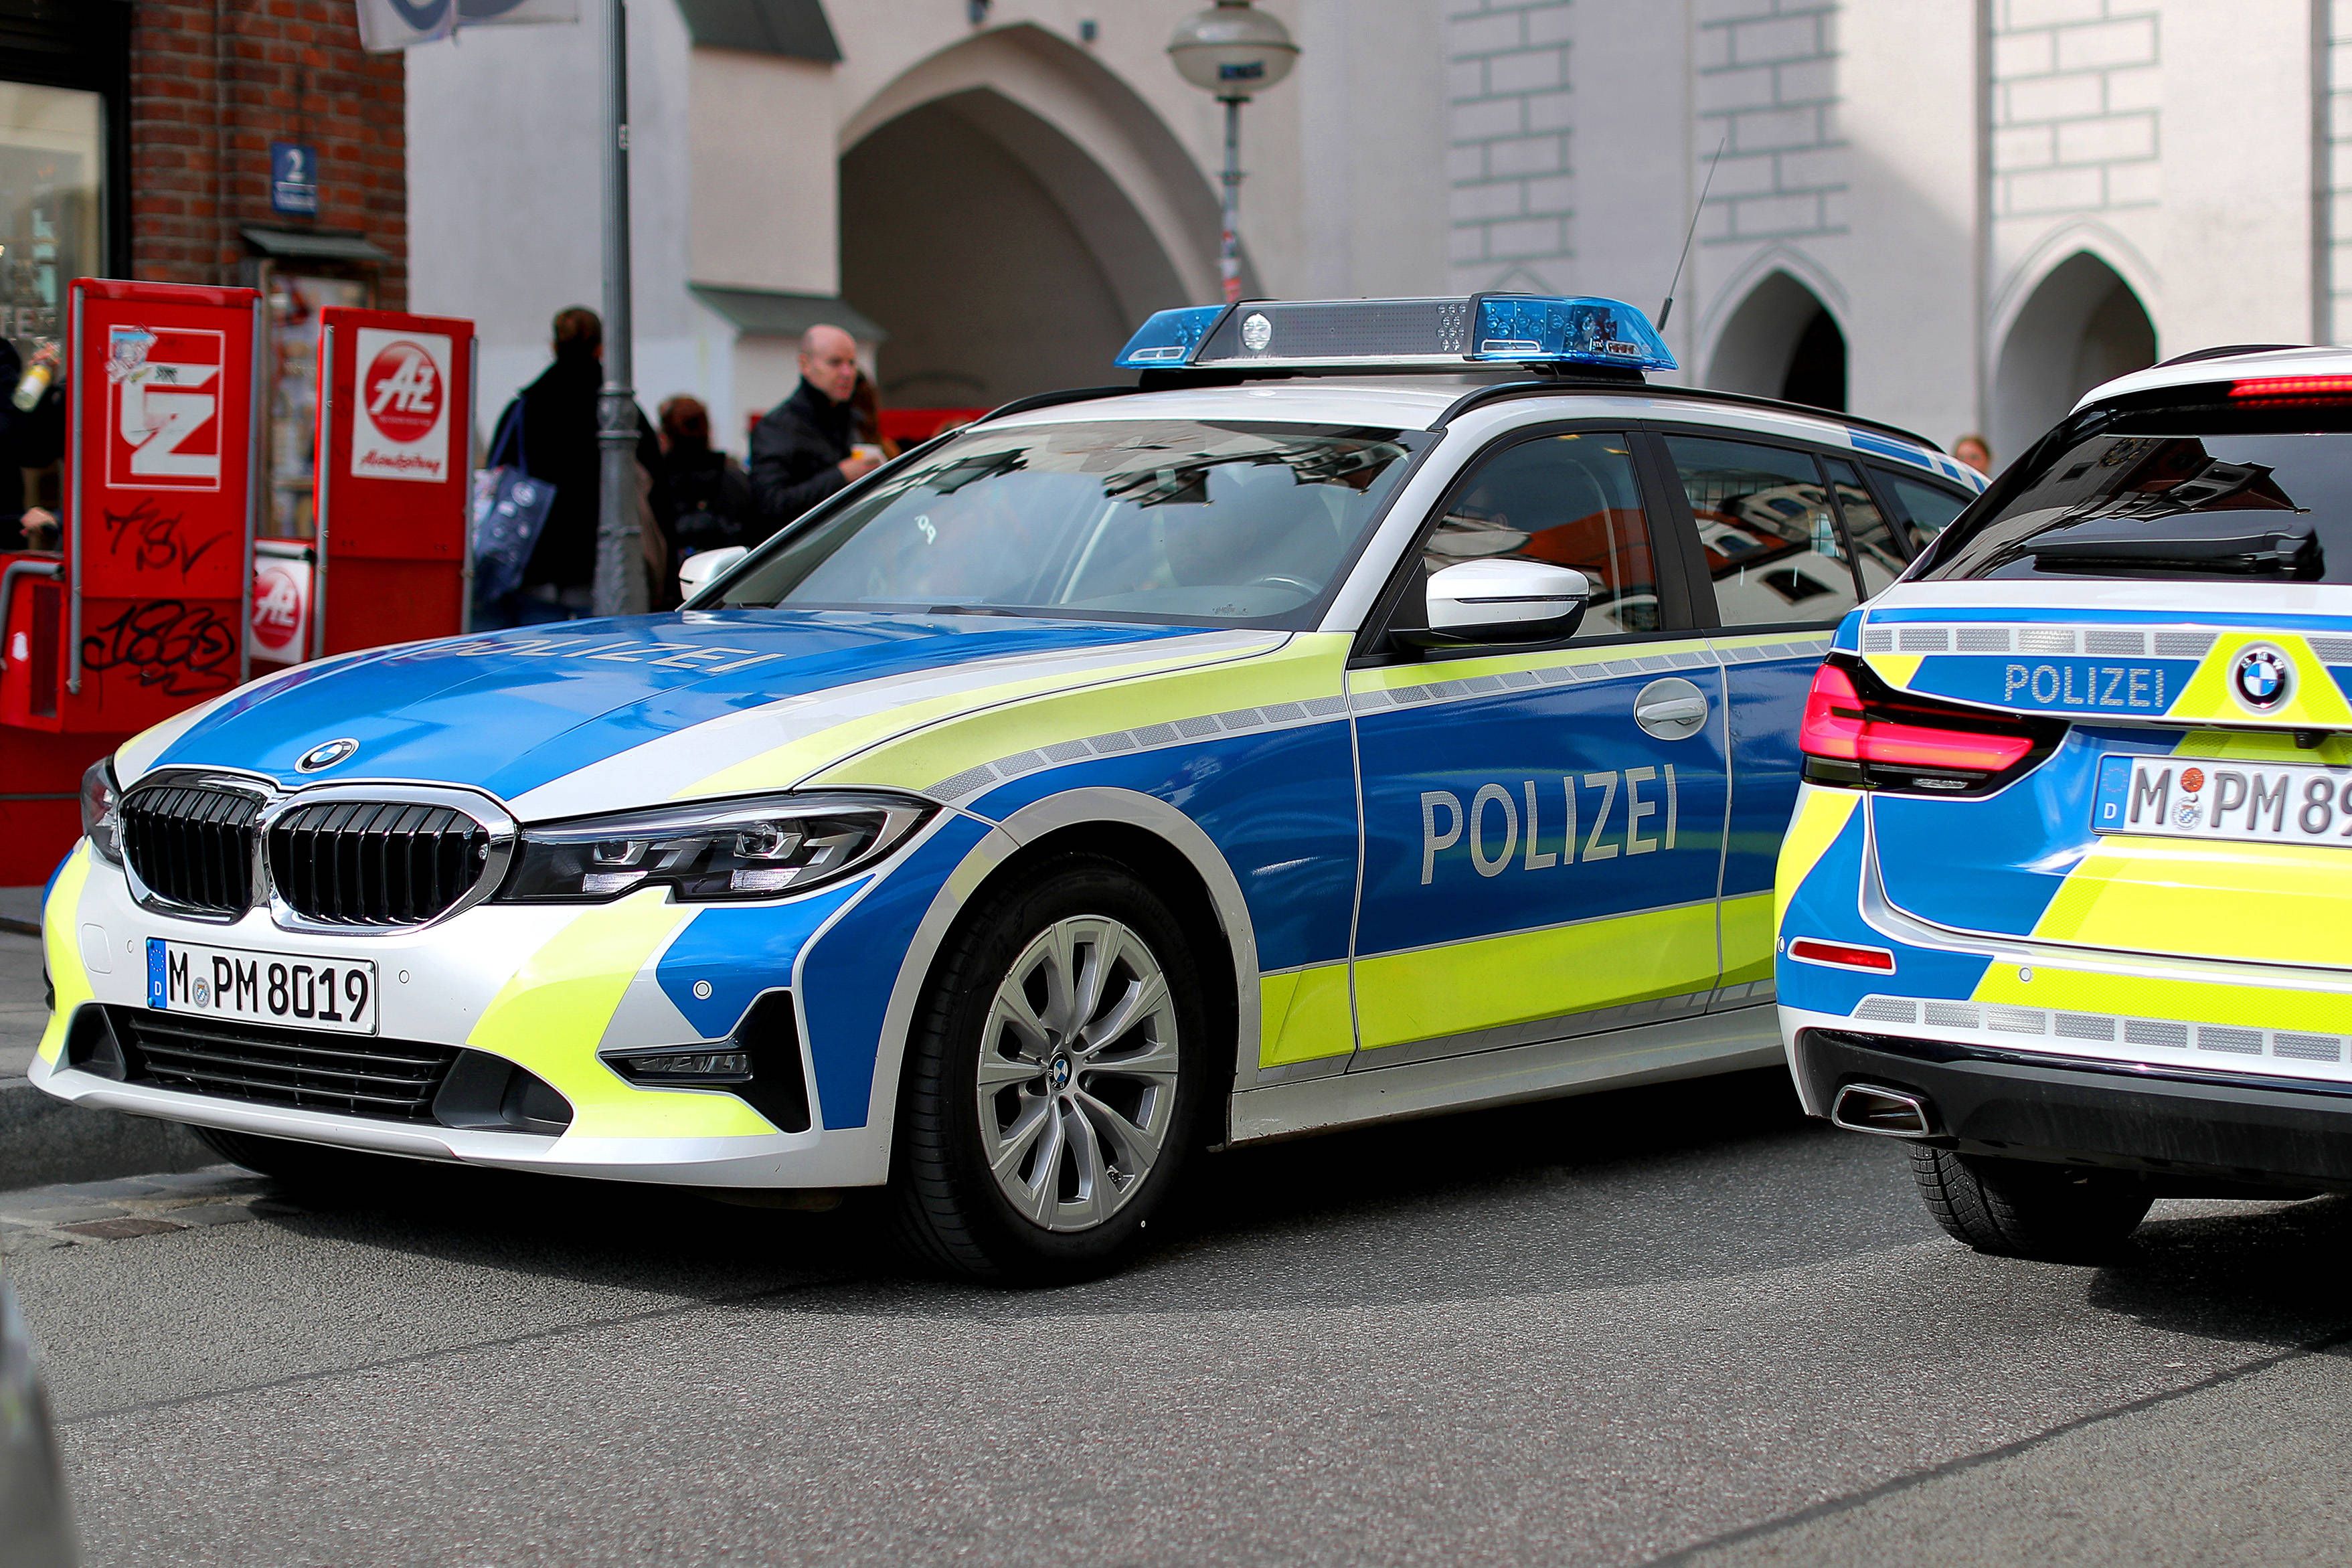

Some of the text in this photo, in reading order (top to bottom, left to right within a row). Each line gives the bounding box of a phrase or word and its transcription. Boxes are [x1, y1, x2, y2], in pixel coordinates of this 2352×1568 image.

[286, 149, 303, 181] 2
[390, 639, 786, 672] POLIZEI
[2241, 651, 2284, 670] BMW
[2004, 664, 2164, 707] POLIZEI
[2103, 803, 2117, 820] D
[2130, 765, 2170, 824] M
[2210, 770, 2288, 832] PM
[1420, 764, 1677, 885] POLIZEI
[155, 981, 162, 996] D
[169, 950, 369, 1022] M PM 8019
